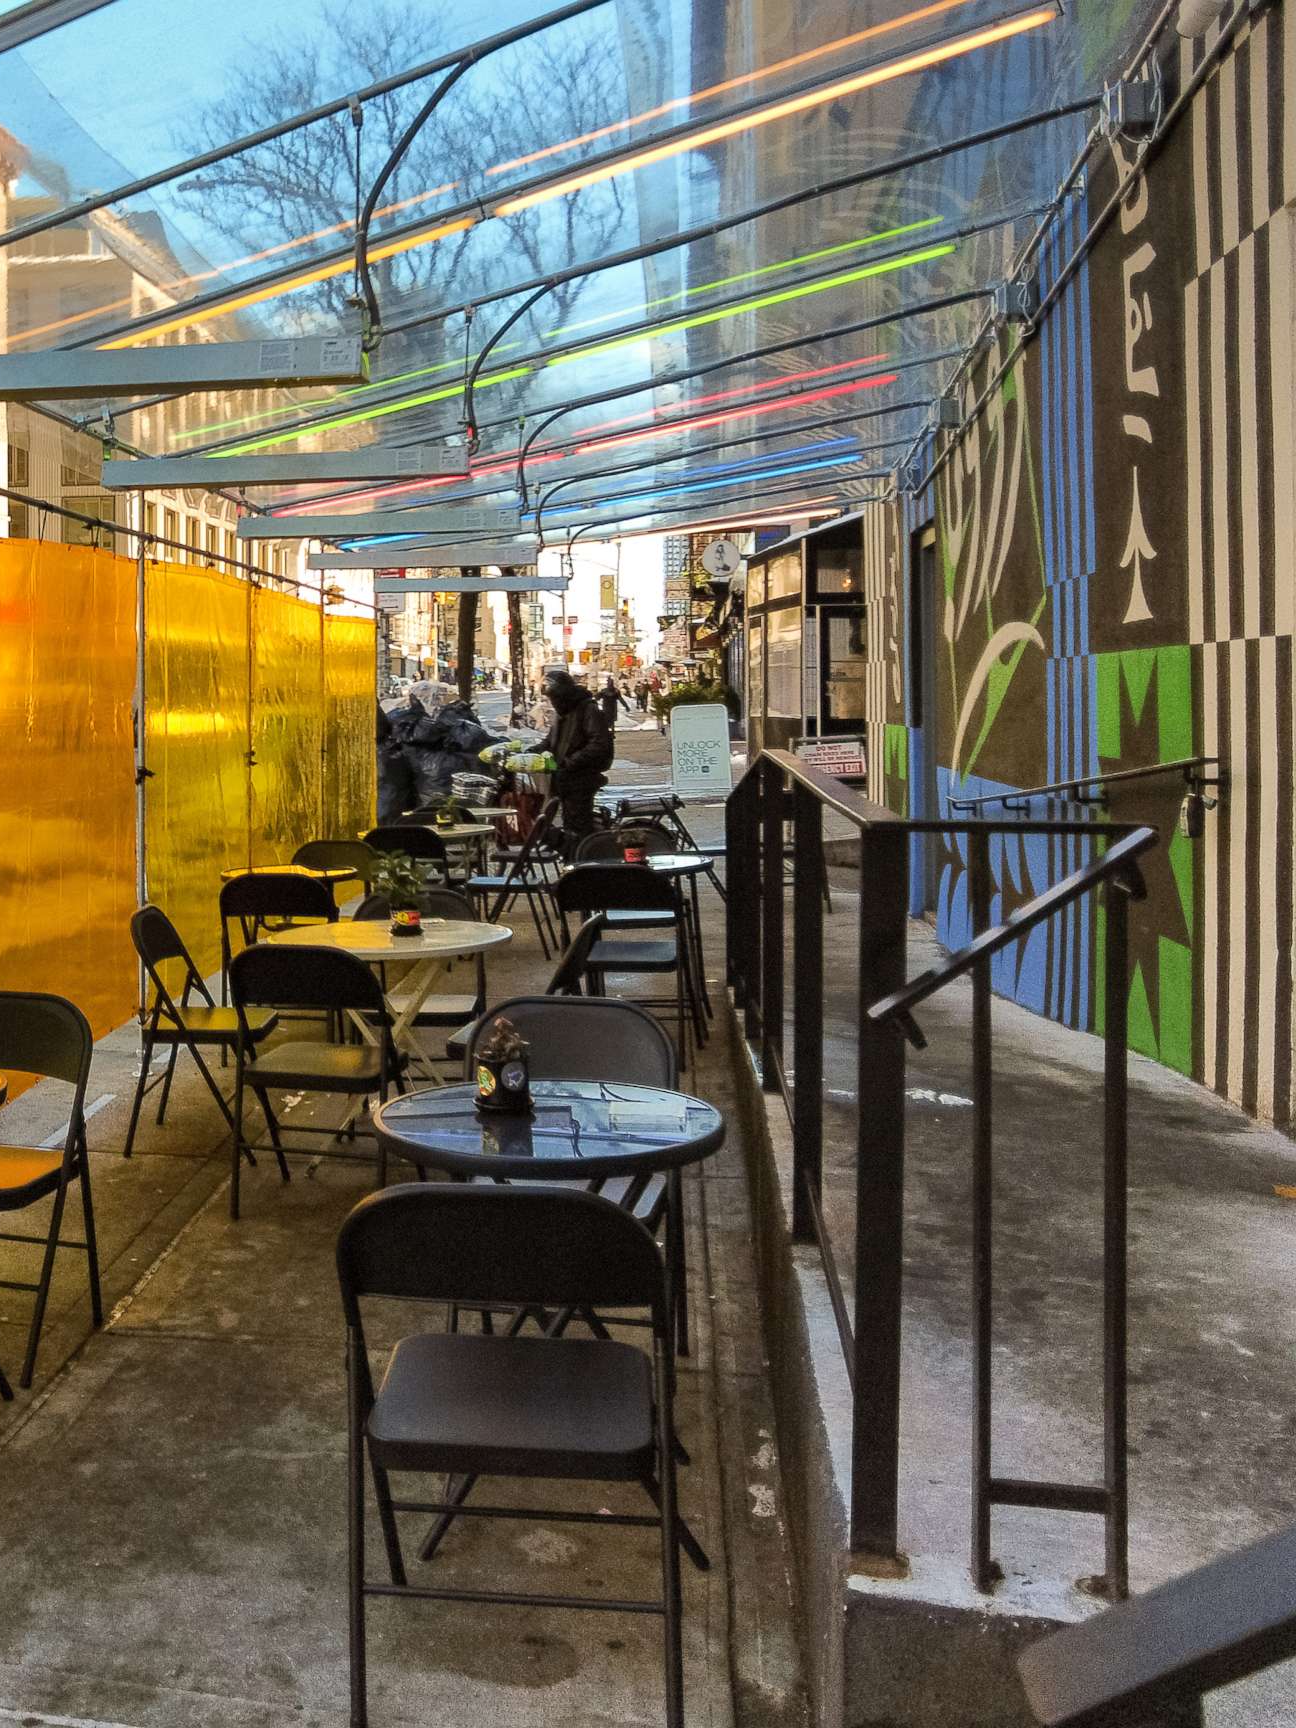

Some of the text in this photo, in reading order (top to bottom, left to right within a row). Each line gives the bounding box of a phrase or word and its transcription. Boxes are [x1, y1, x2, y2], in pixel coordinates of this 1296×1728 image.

[676, 740, 721, 750] UNLOCK
[676, 749, 708, 758] MORE
[677, 757, 719, 767] ON THE
[678, 766, 700, 774] APP
